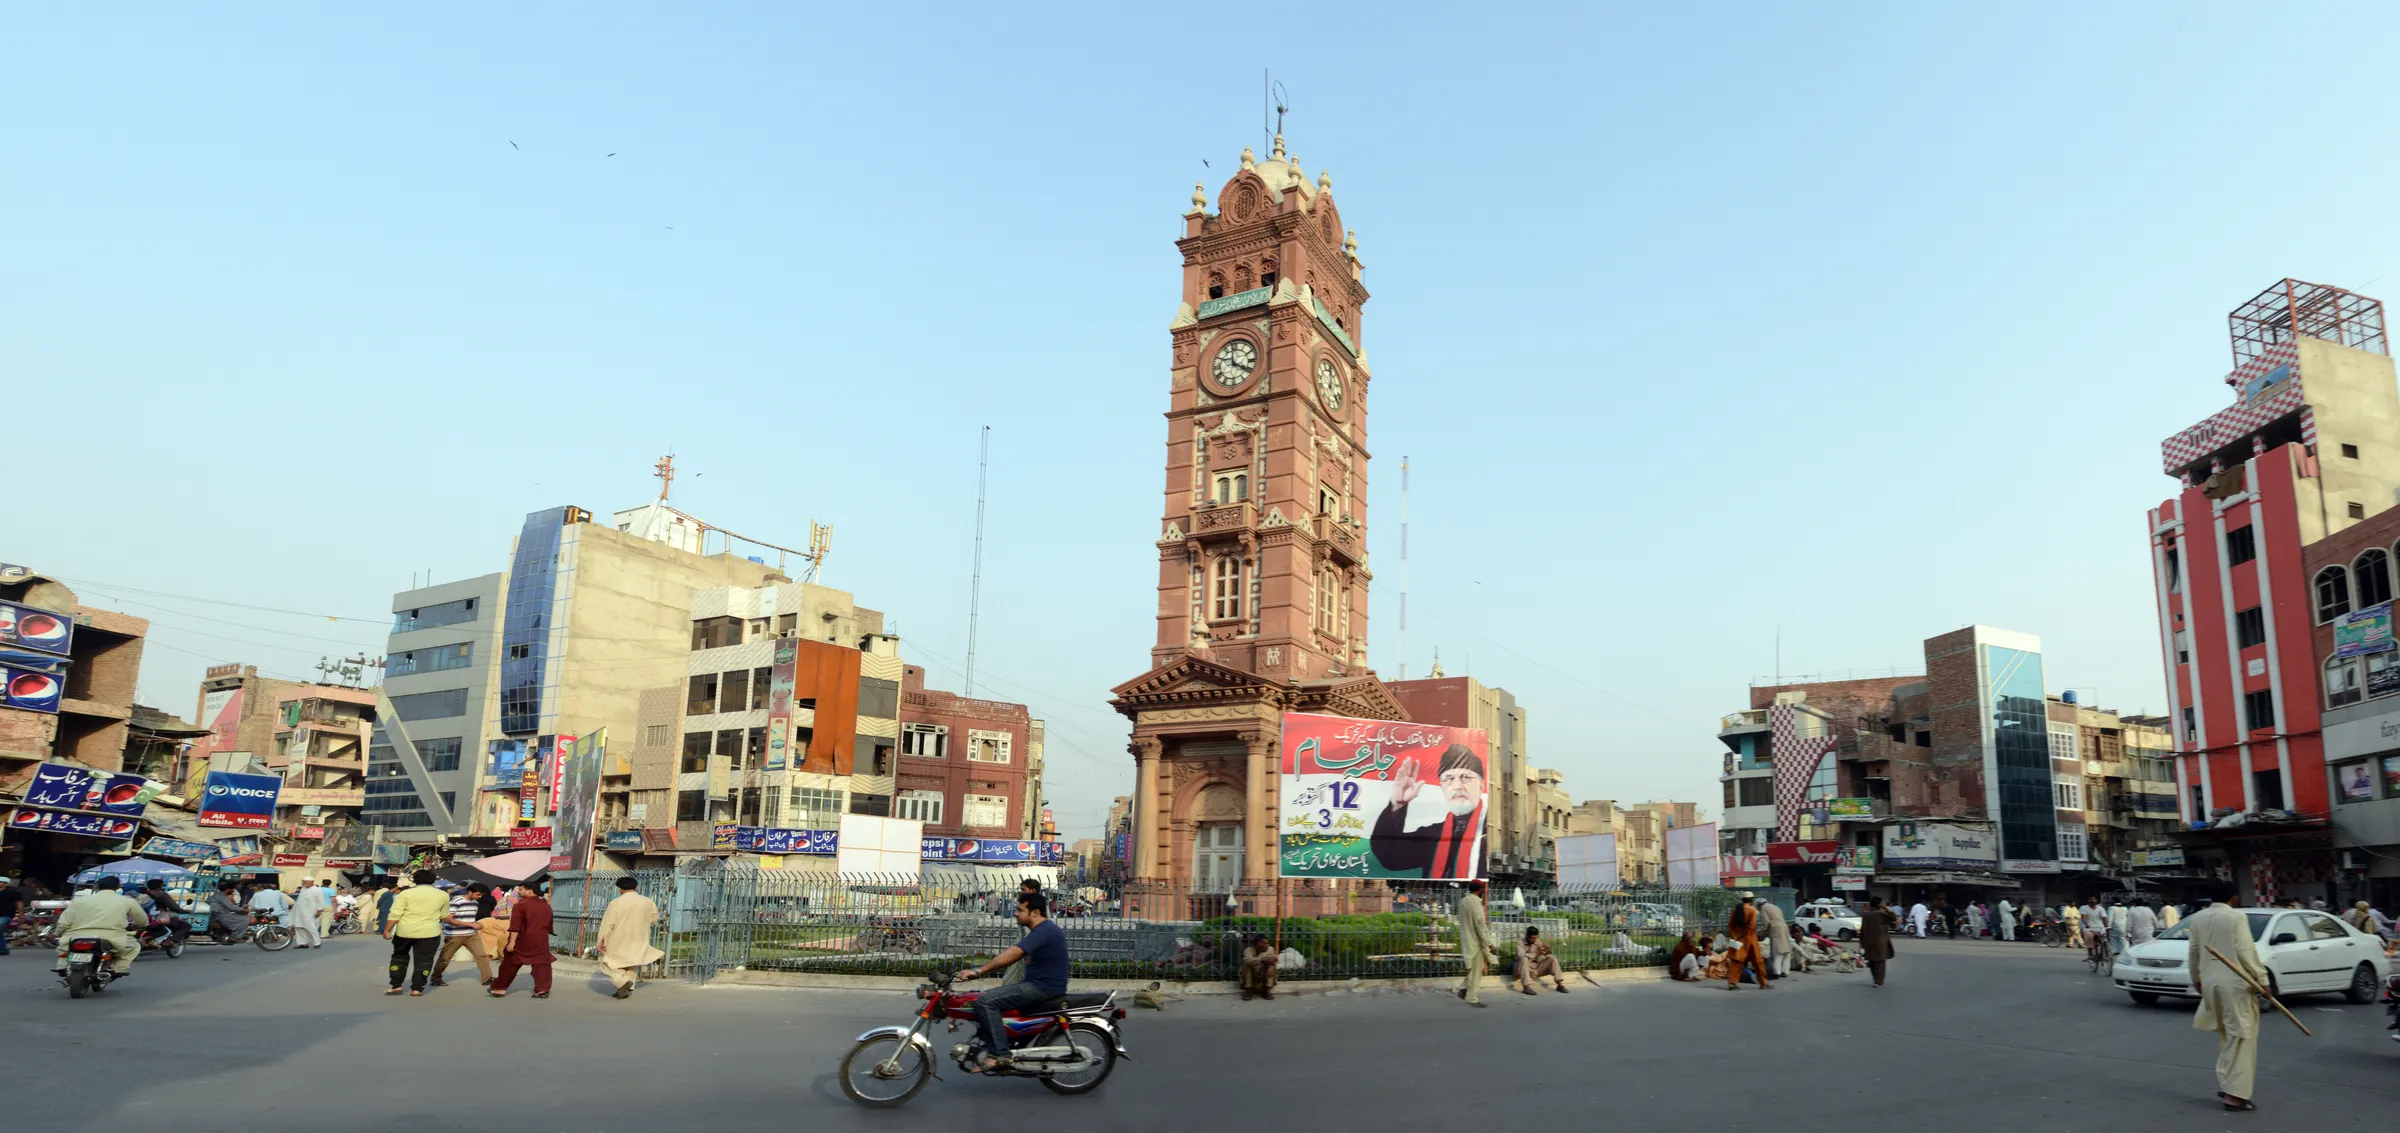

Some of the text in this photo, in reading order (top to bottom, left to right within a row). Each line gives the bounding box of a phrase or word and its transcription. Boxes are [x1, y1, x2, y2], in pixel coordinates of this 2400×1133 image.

[1293, 736, 1373, 782] عام
[229, 787, 276, 799] VOICE
[1328, 781, 1359, 809] 12
[1318, 808, 1331, 828] 3
[922, 839, 945, 848] epsi
[922, 849, 943, 858] oint
[1809, 852, 1836, 862] TCS
